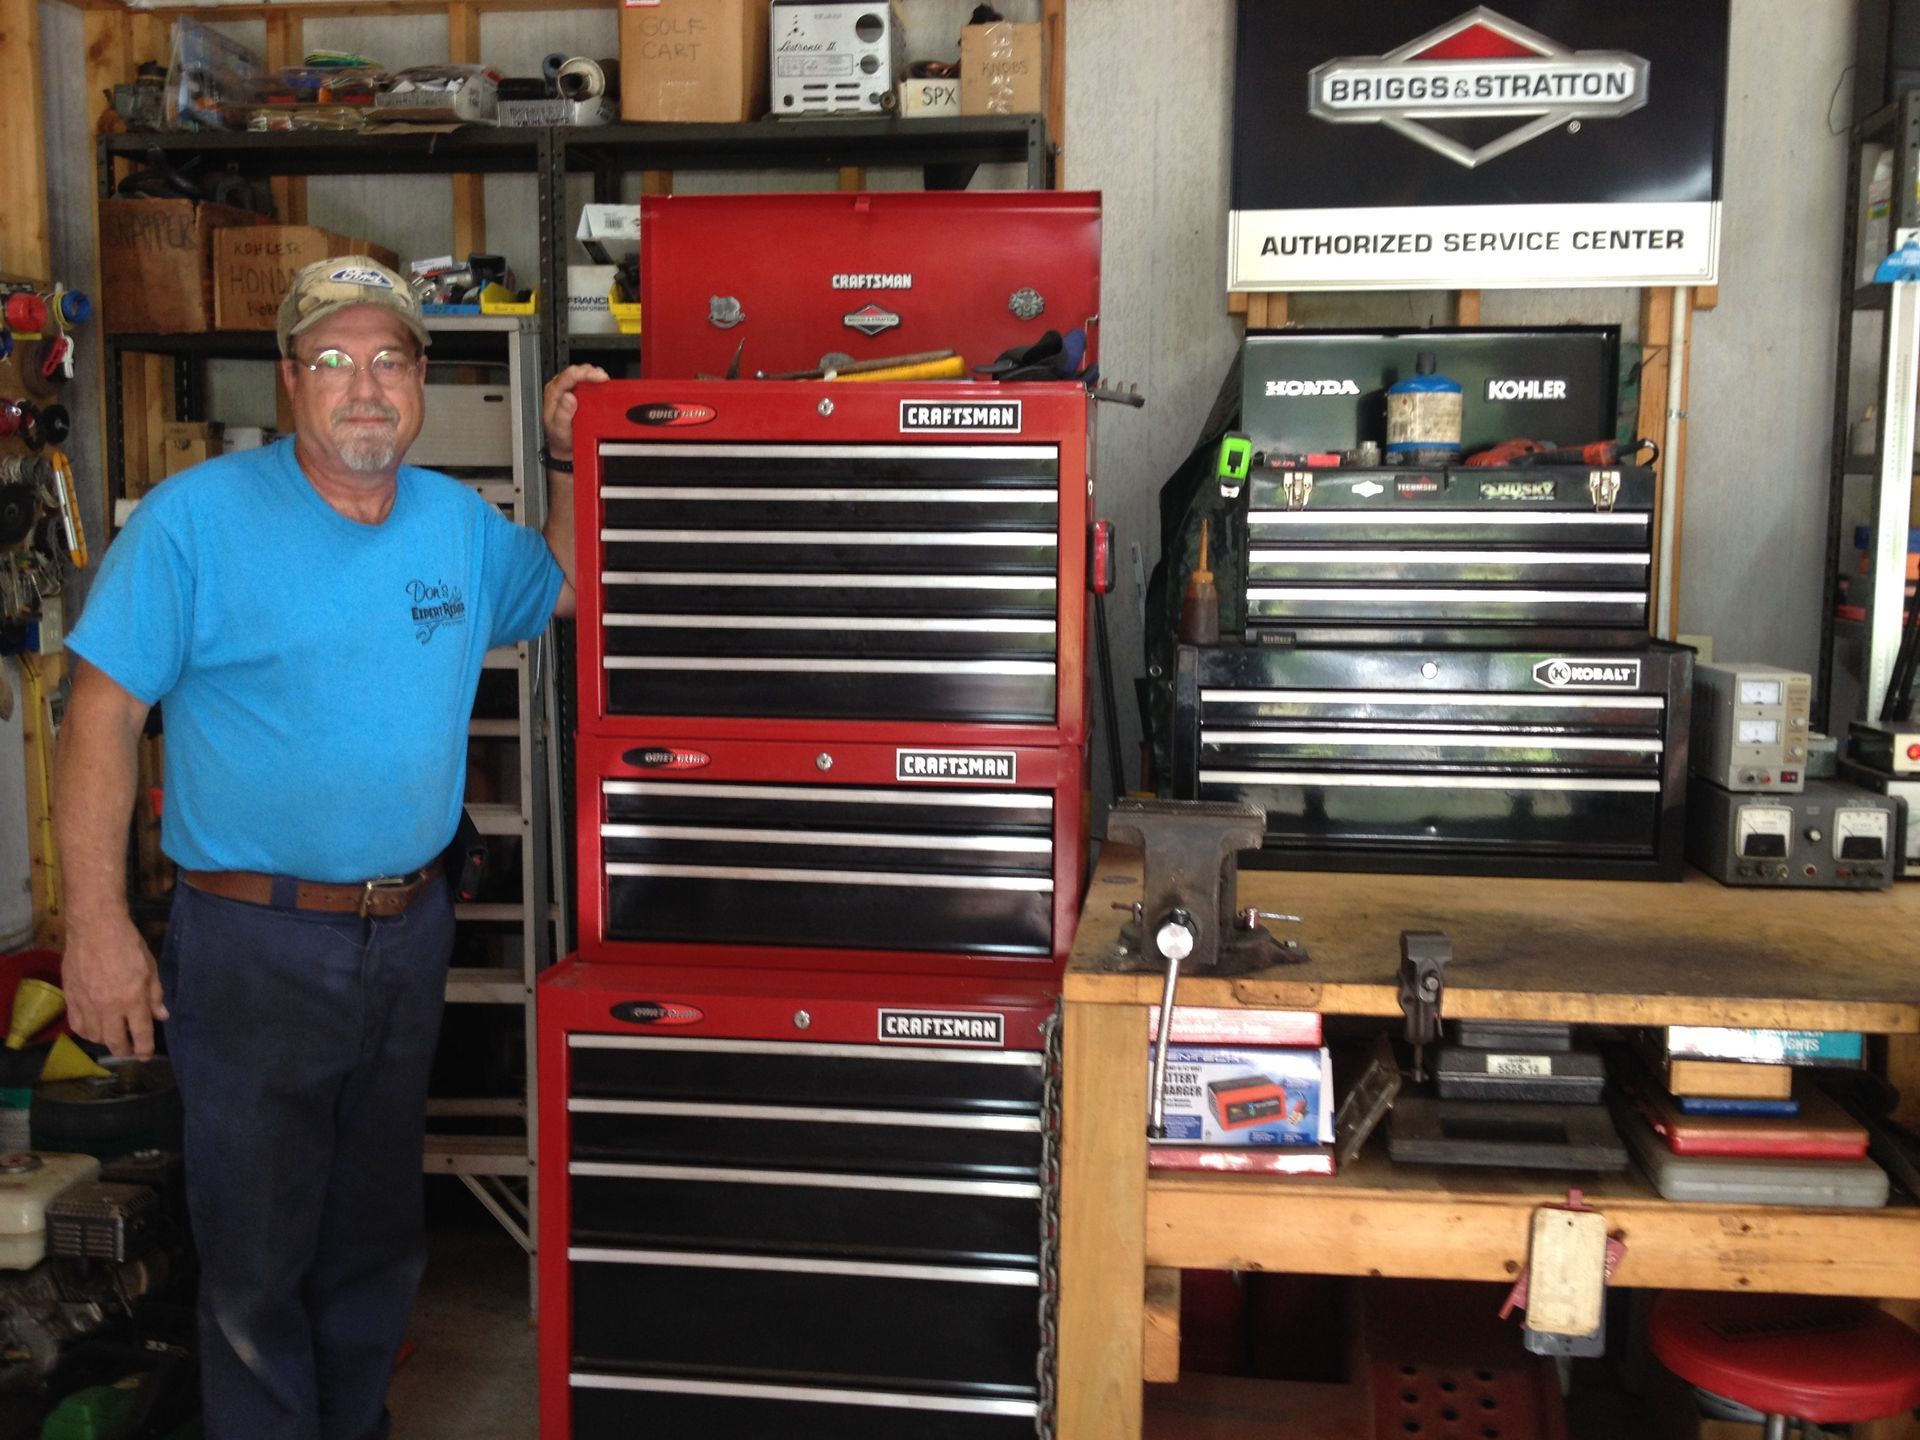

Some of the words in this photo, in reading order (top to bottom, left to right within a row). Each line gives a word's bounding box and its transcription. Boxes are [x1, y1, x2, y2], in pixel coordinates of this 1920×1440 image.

[641, 16, 706, 36] GOLF
[642, 41, 700, 60] CART
[982, 61, 1028, 75] KNOBS
[922, 86, 957, 106] SPX
[1260, 233, 1433, 257] AUTHORIZED
[1443, 231, 1561, 253] SERVICE
[1572, 229, 1685, 250] CENTER
[831, 274, 913, 289] CRAFTSMAN
[1265, 380, 1360, 396] HONDA
[1488, 380, 1567, 400] KOHLER
[907, 407, 1013, 426] CRAFTSMAN
[405, 578, 449, 603] Don's
[1571, 667, 1631, 682] KOBALT
[904, 756, 1009, 776] CRAFTSMAN
[885, 1016, 997, 1038] CRAFTSMAN
